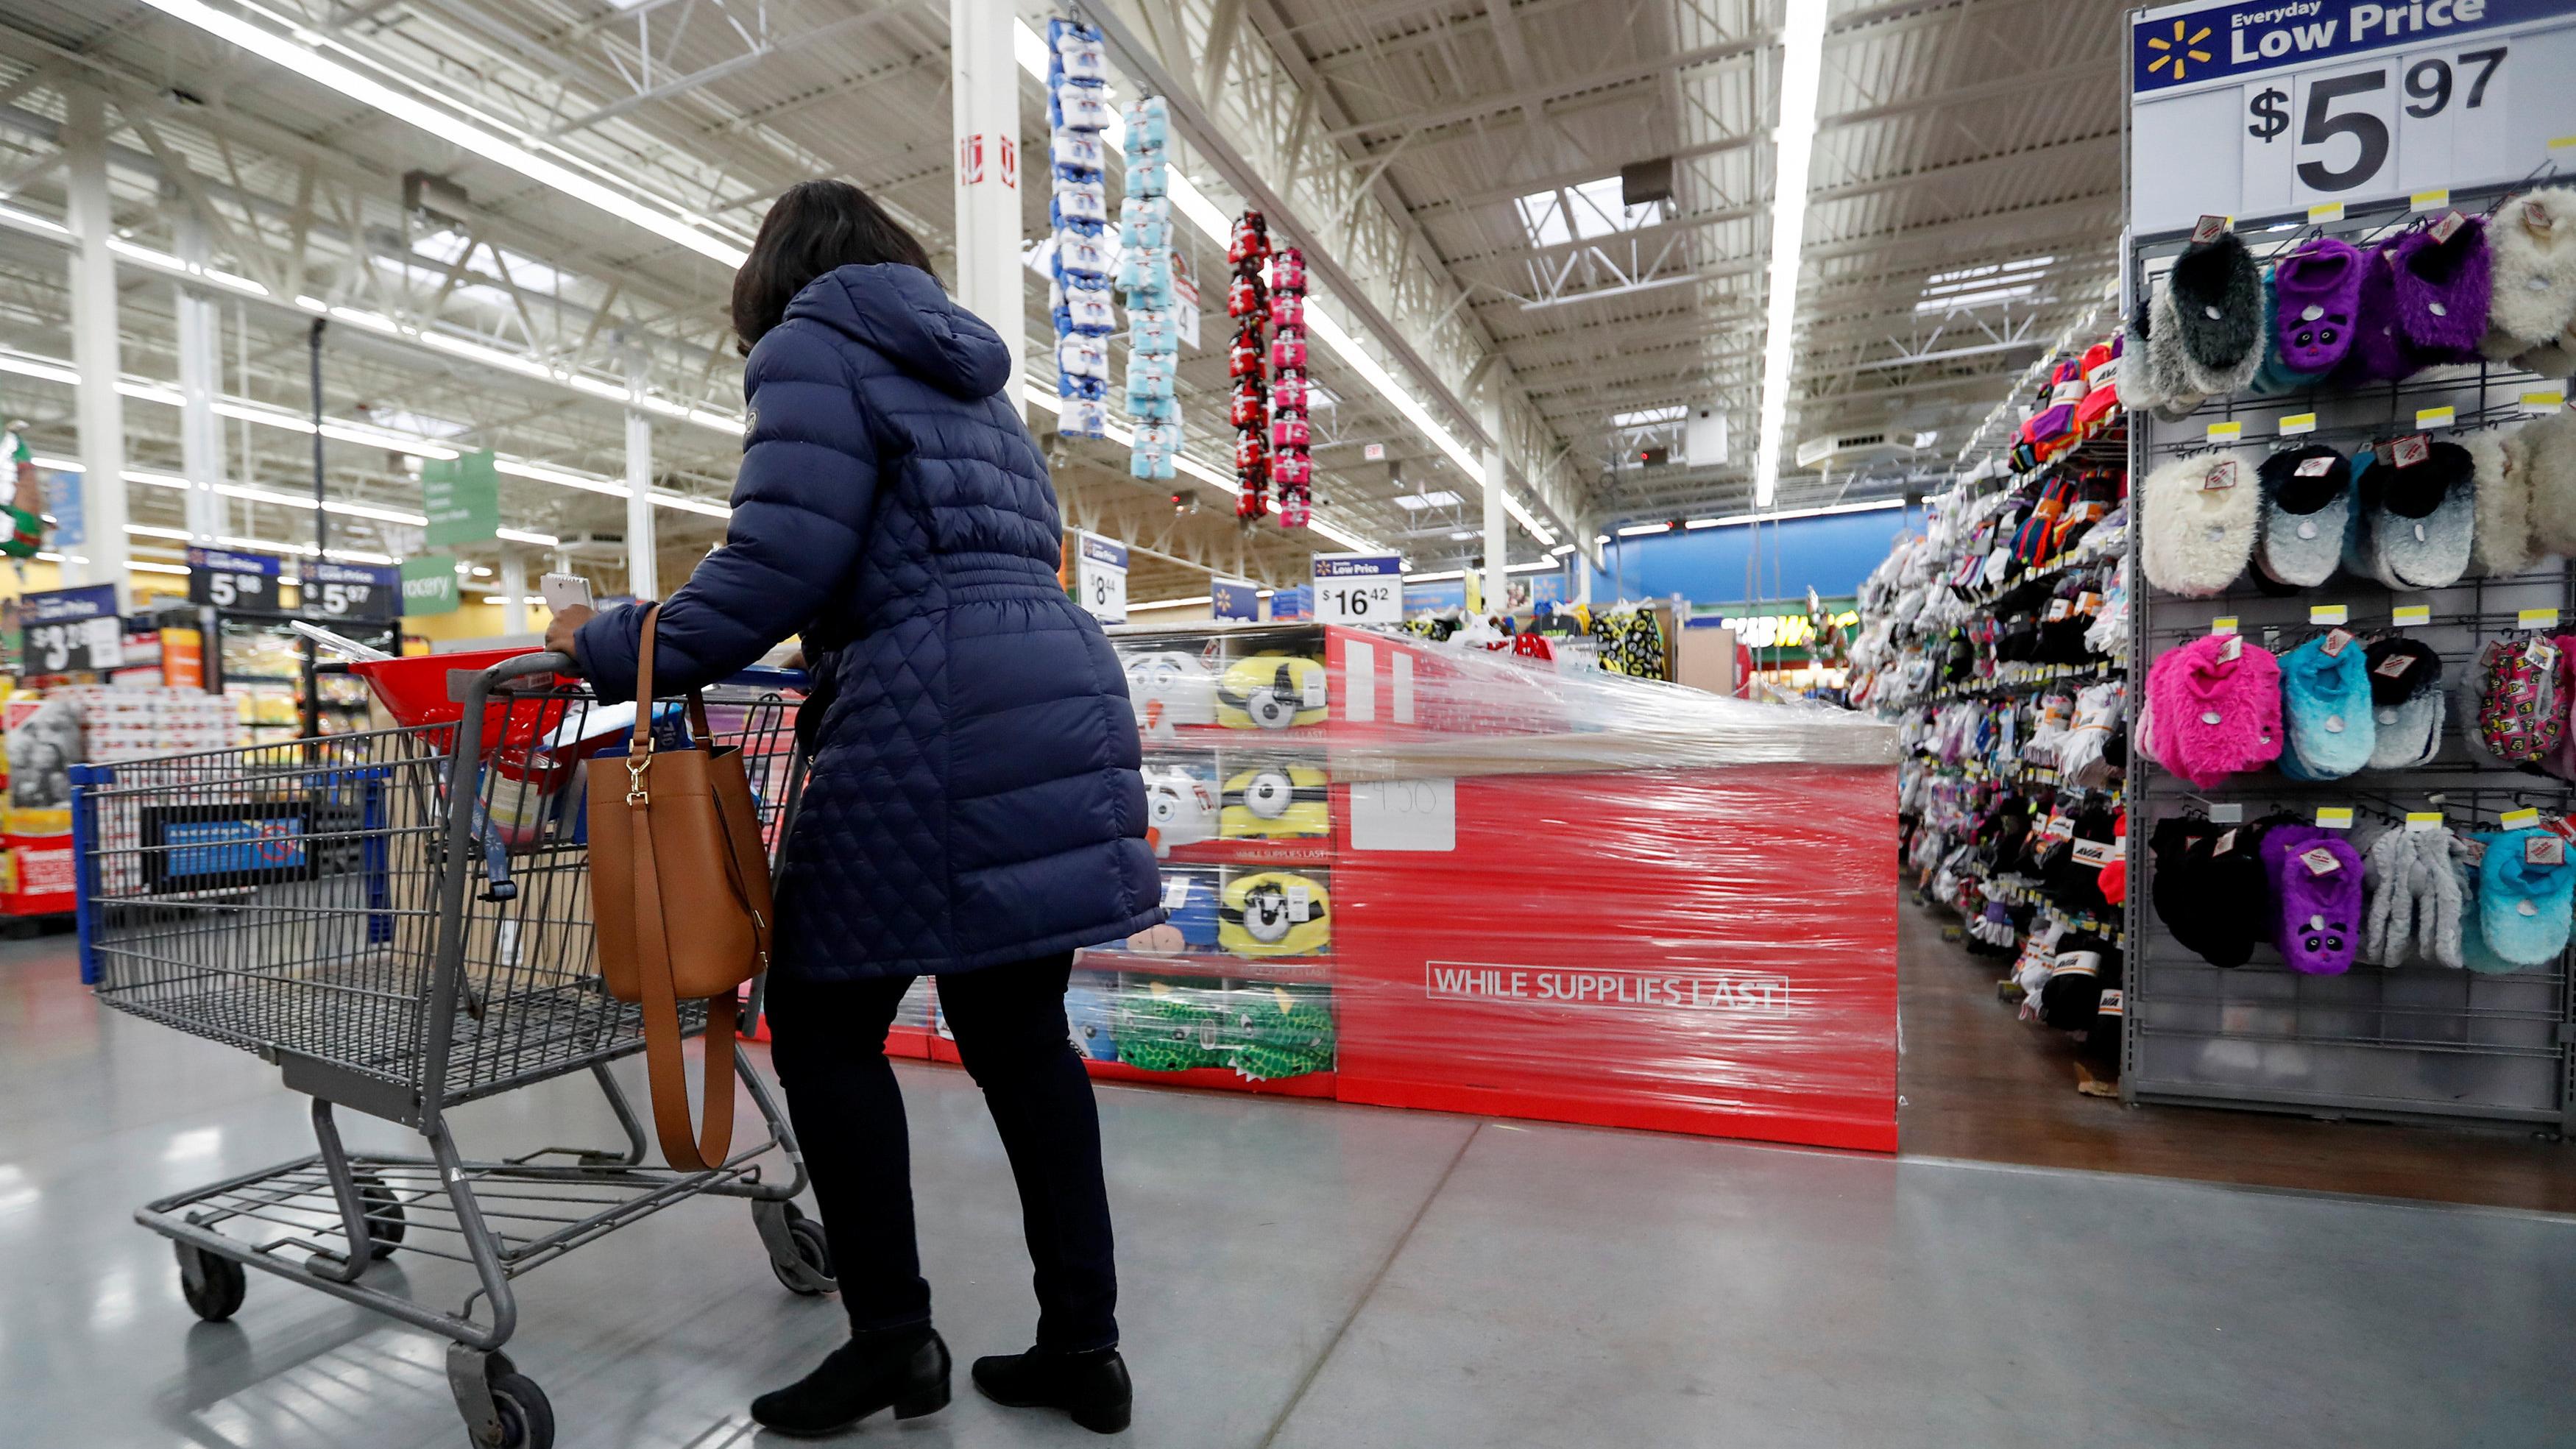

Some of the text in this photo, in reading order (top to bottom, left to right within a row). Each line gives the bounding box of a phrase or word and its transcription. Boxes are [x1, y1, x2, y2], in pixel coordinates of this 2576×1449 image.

[2231, 1, 2321, 28] Everyday
[2232, 0, 2486, 65] Low Price
[1333, 565, 1354, 574] Low
[1354, 564, 1379, 573] Price
[401, 577, 450, 600] rocery
[1435, 968, 1779, 1010] WHILE SUPPLIES LAST
